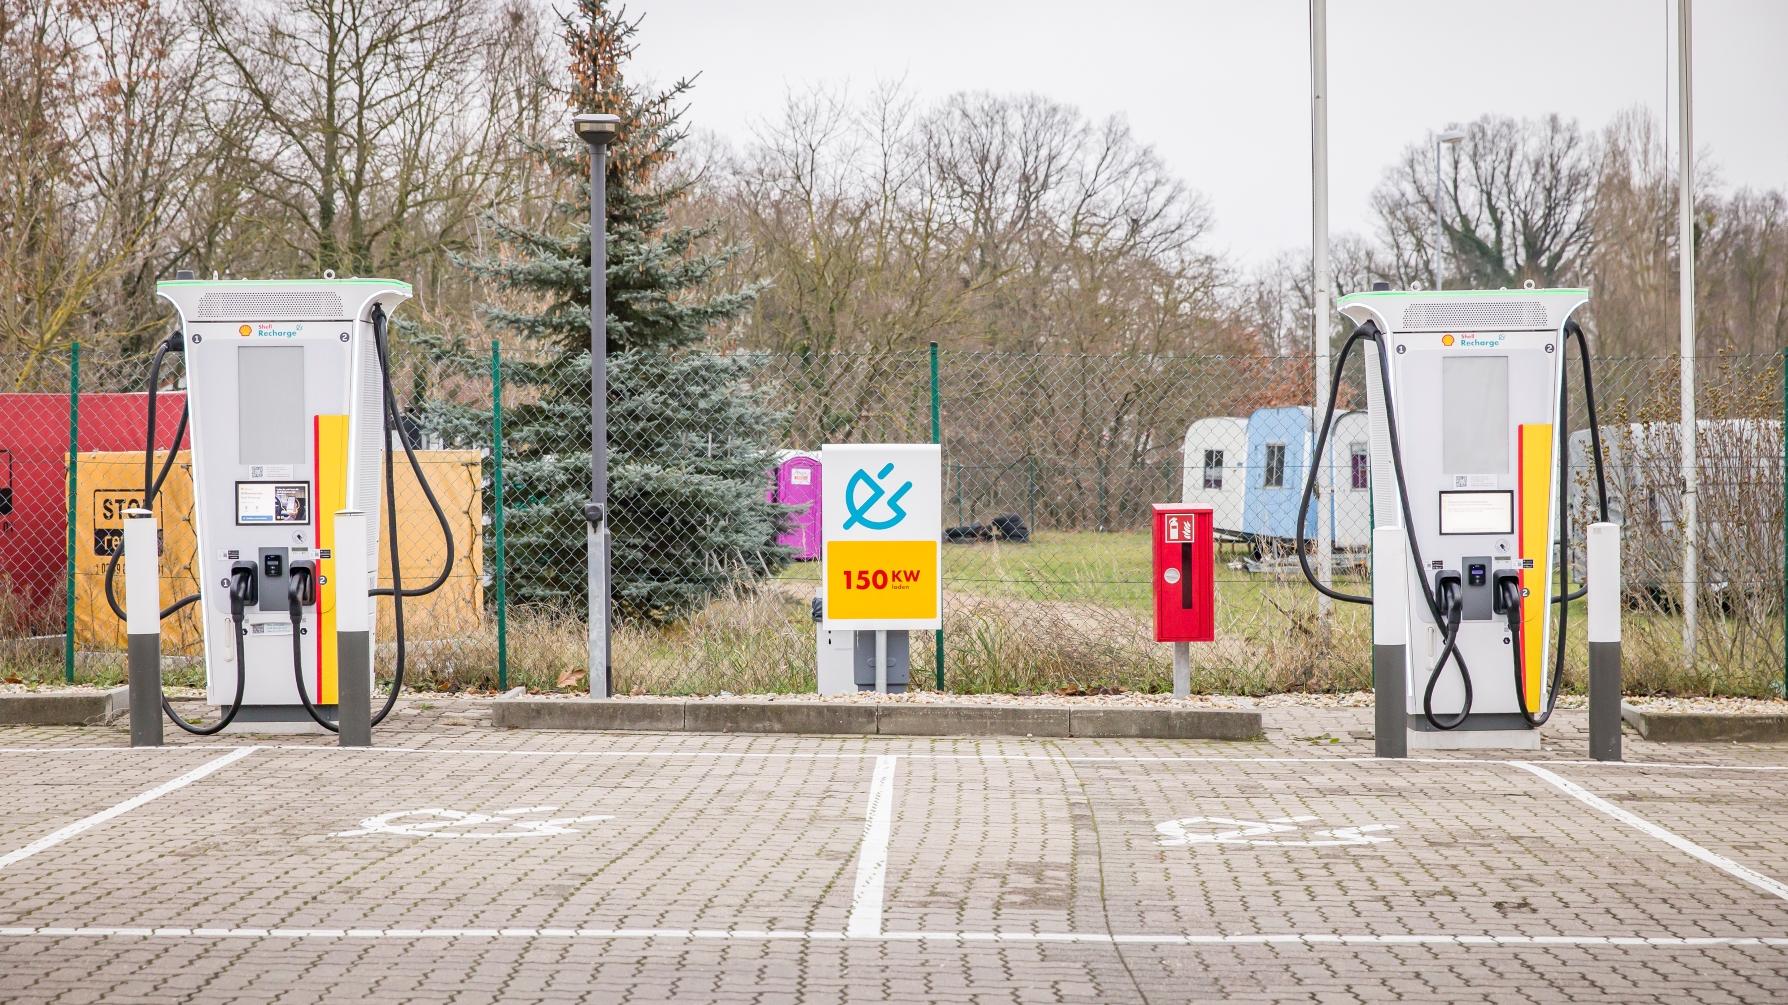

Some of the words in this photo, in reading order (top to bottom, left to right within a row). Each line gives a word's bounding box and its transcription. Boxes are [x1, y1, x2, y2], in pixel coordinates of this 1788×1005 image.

[258, 330, 297, 338] Recharge
[1460, 339, 1499, 347] Recharge
[103, 498, 145, 520] STO
[843, 569, 888, 590] 150
[892, 570, 920, 582] KW
